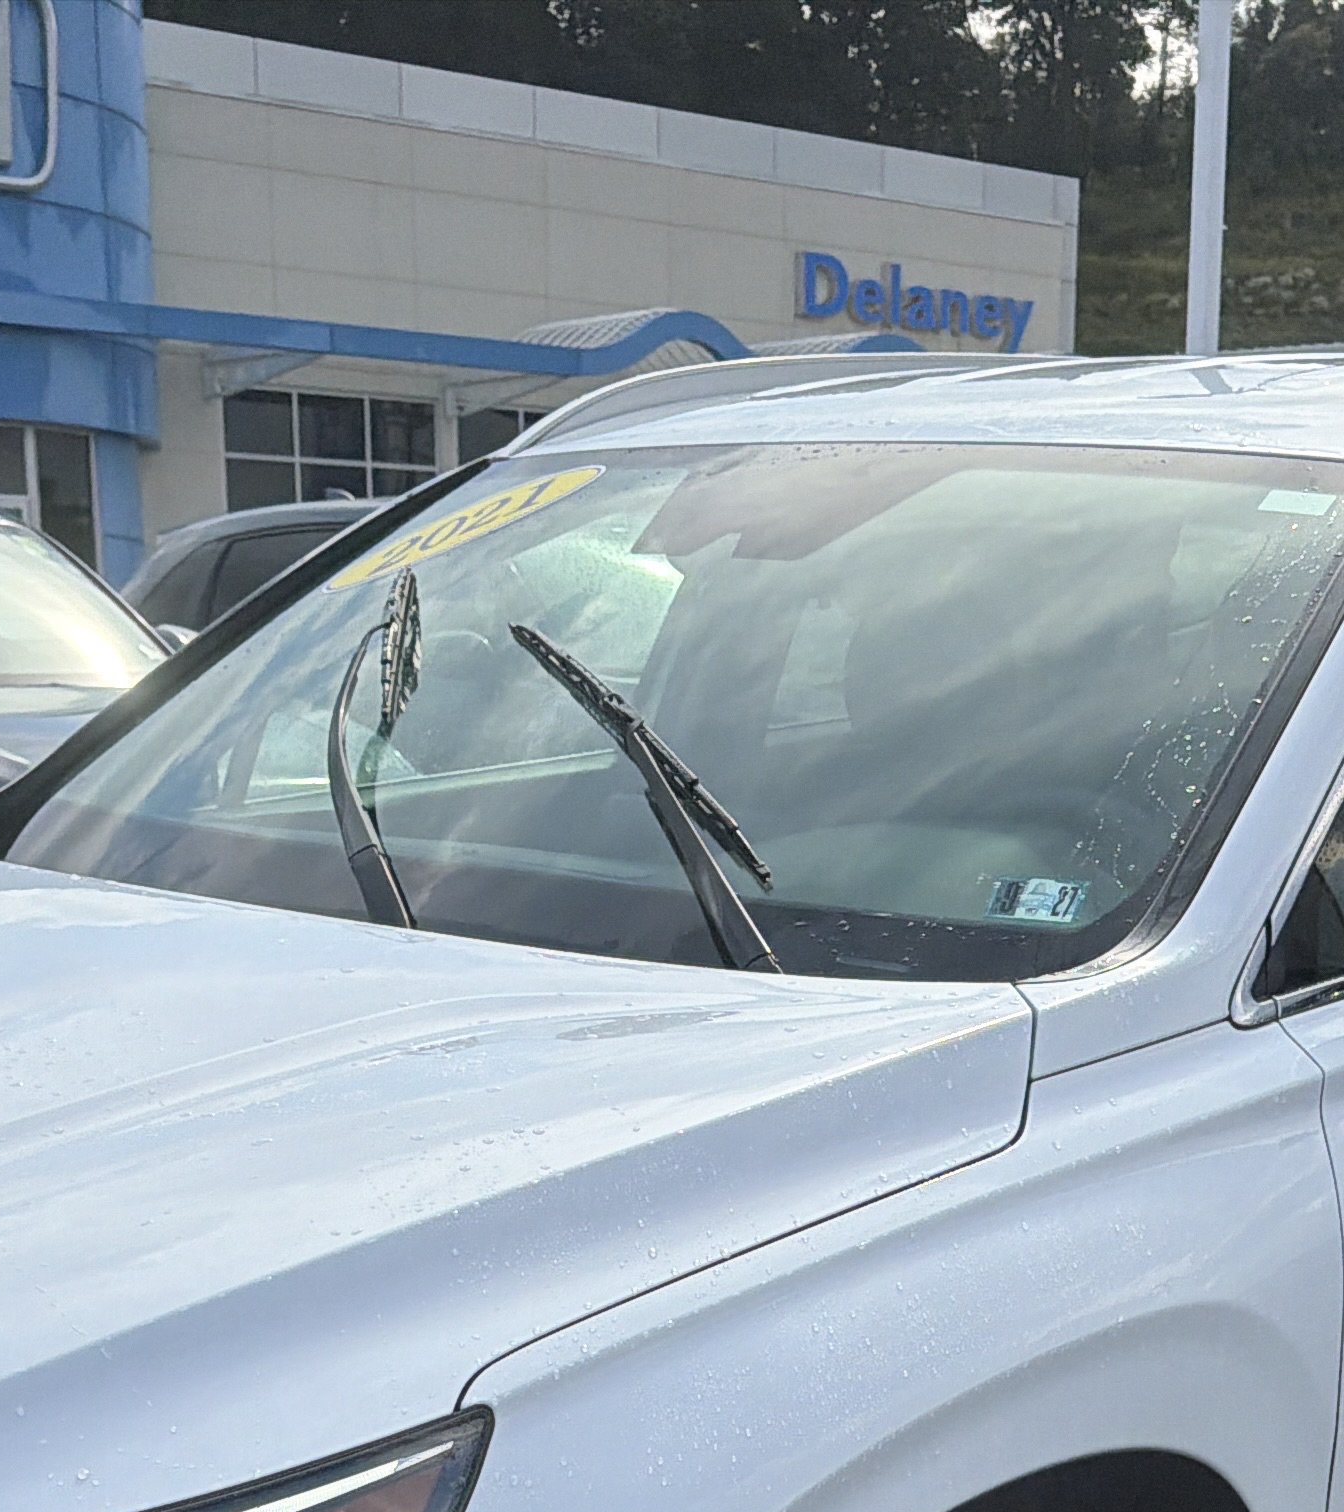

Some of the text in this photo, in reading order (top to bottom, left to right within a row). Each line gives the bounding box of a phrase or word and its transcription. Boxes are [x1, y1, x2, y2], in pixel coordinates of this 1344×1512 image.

[799, 251, 1034, 354] Delaney
[366, 477, 555, 578] 2021
[1049, 885, 1081, 917] 27
